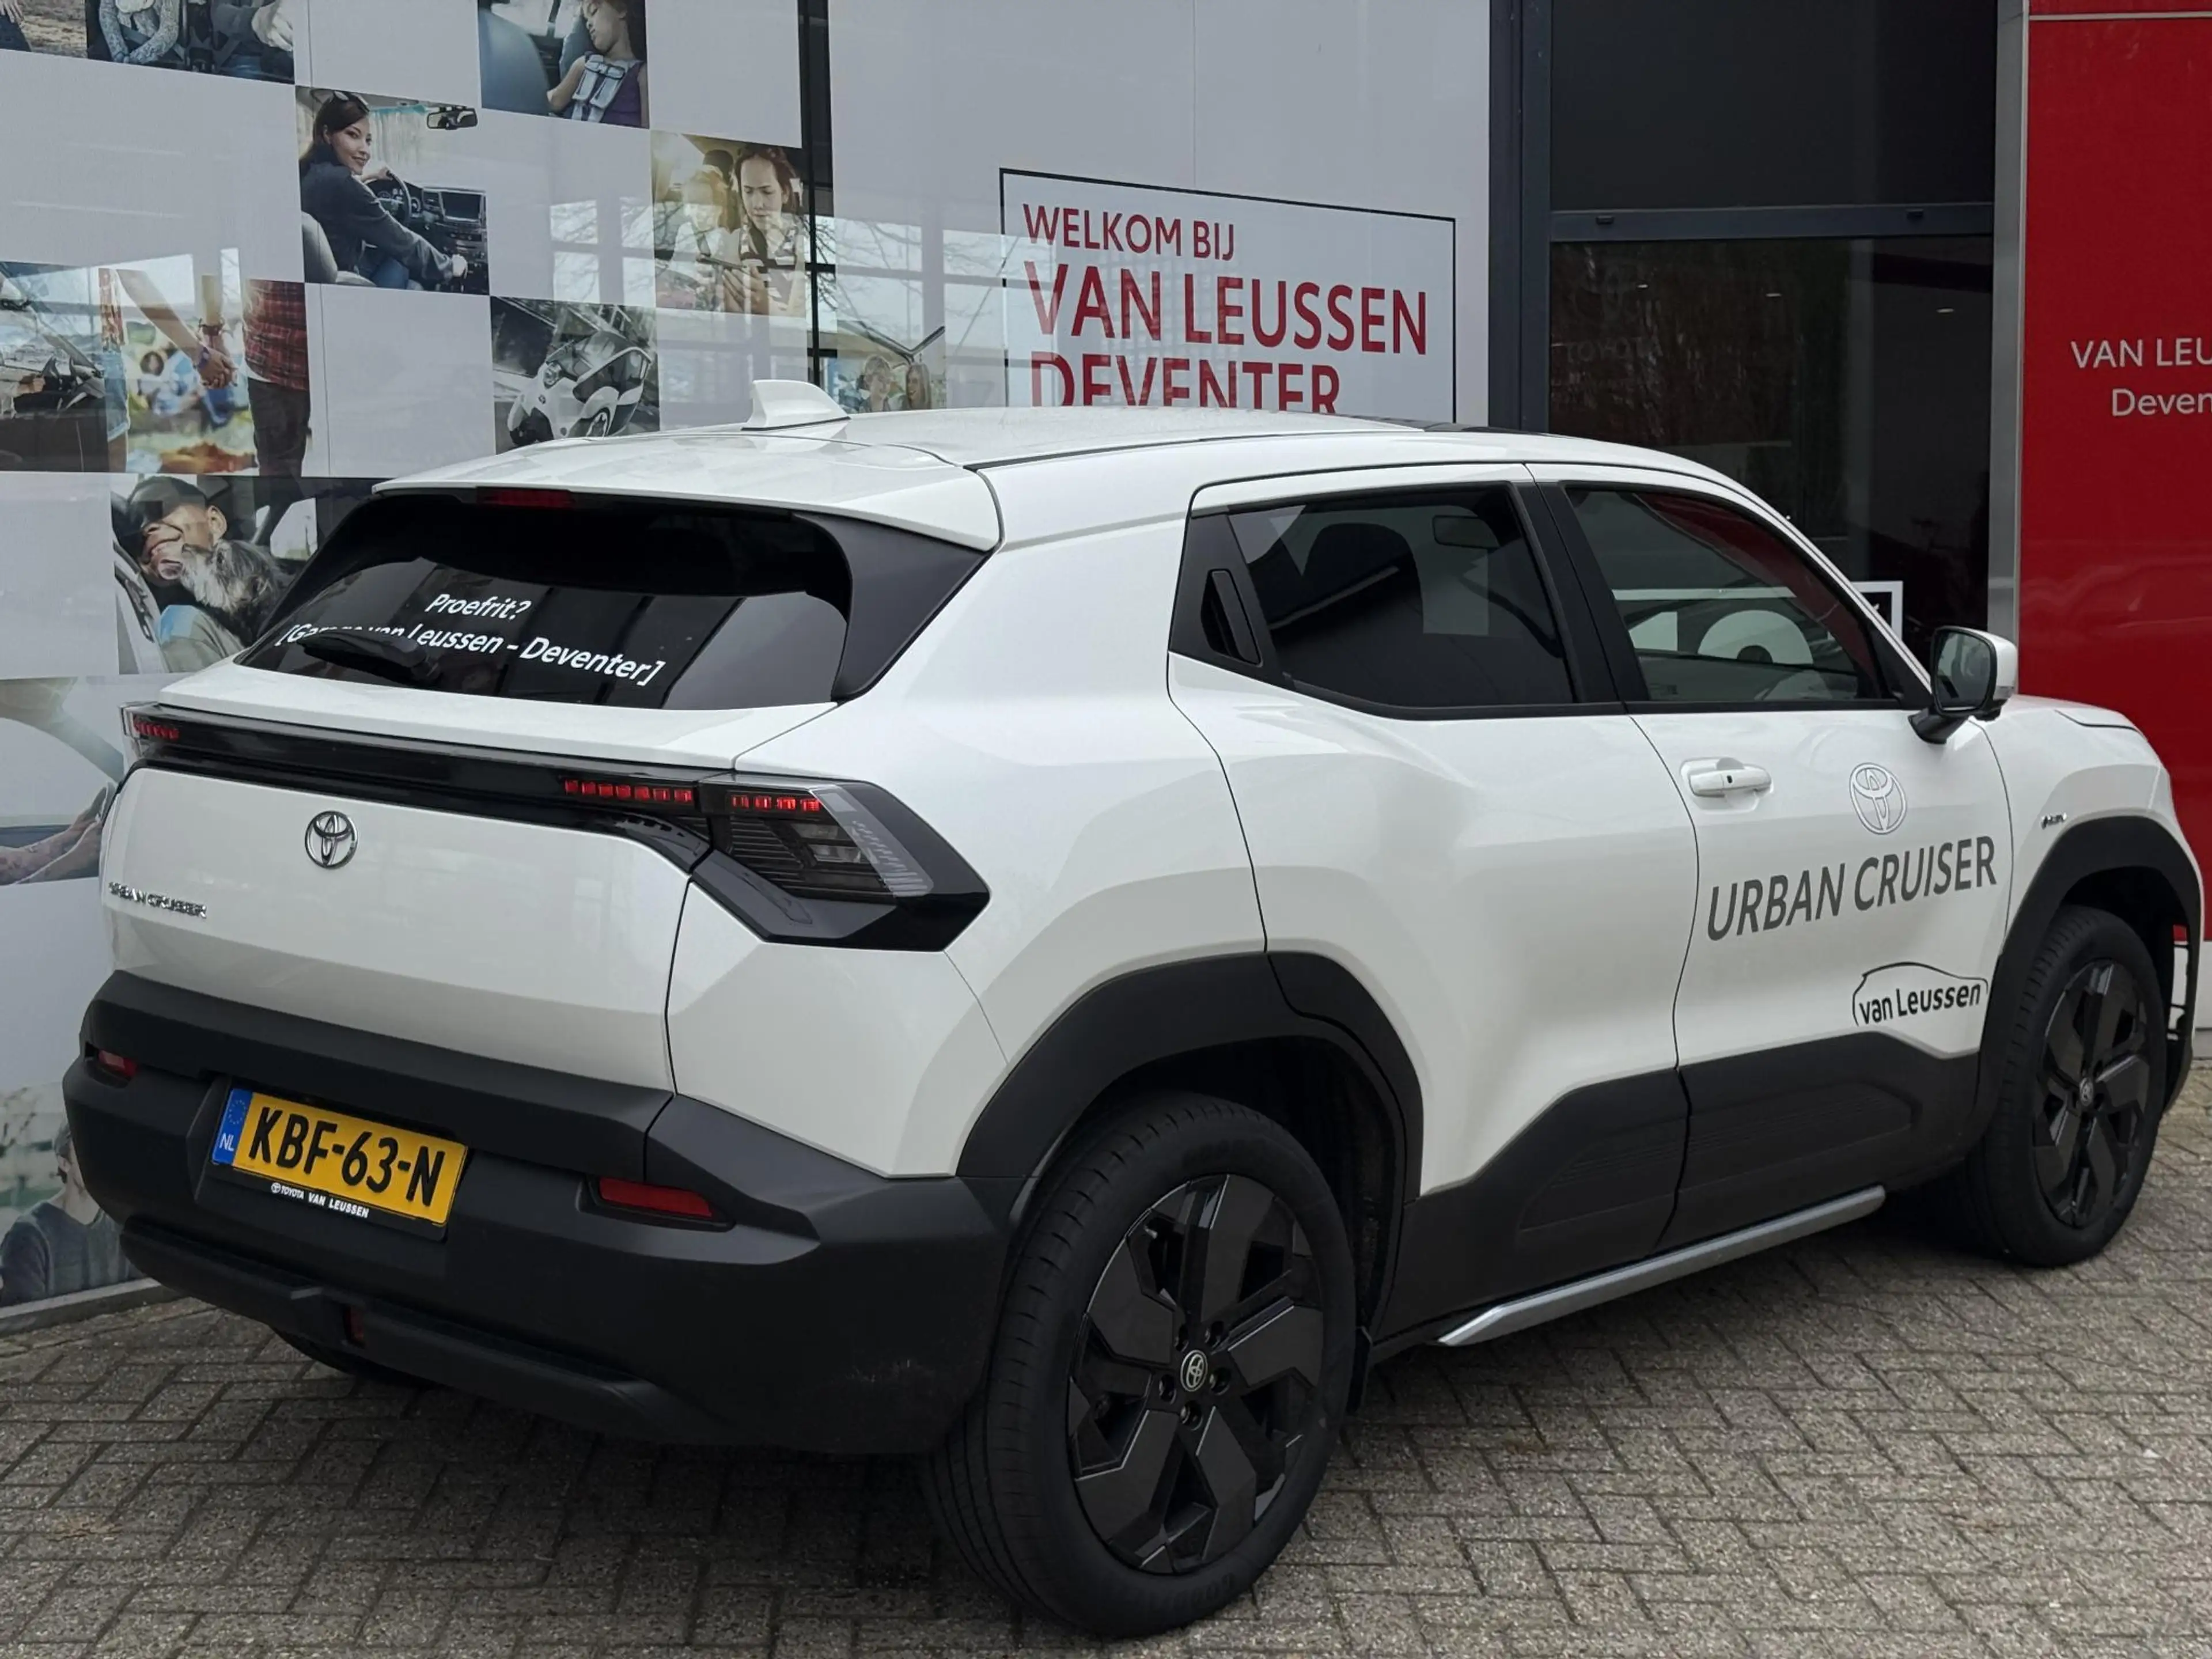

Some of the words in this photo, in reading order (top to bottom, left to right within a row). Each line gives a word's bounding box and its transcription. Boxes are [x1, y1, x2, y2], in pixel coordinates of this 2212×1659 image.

[1022, 203, 1181, 257] WELKOM
[1193, 221, 1234, 261] BIJ
[1023, 261, 1160, 341] VAN
[1185, 274, 1427, 355] LEUSSEN
[2071, 339, 2143, 369] VAN
[2157, 337, 2212, 366] LEU
[1031, 351, 1339, 414] DEVENTER
[2112, 388, 2212, 416] Deven
[425, 593, 532, 620] Proefrit?
[519, 637, 666, 687] Deventer]
[1707, 863, 1845, 941] URBAN
[1854, 836, 1997, 912] CRUISER
[1859, 997, 1893, 1025] van
[1896, 983, 1980, 1017] Leussen
[219, 1132, 234, 1152] NL
[248, 1106, 446, 1207] KBF-63-N
[281, 1185, 304, 1199] TOYOTA
[308, 1192, 326, 1206] VAN
[328, 1198, 369, 1218] LEUSSEN
